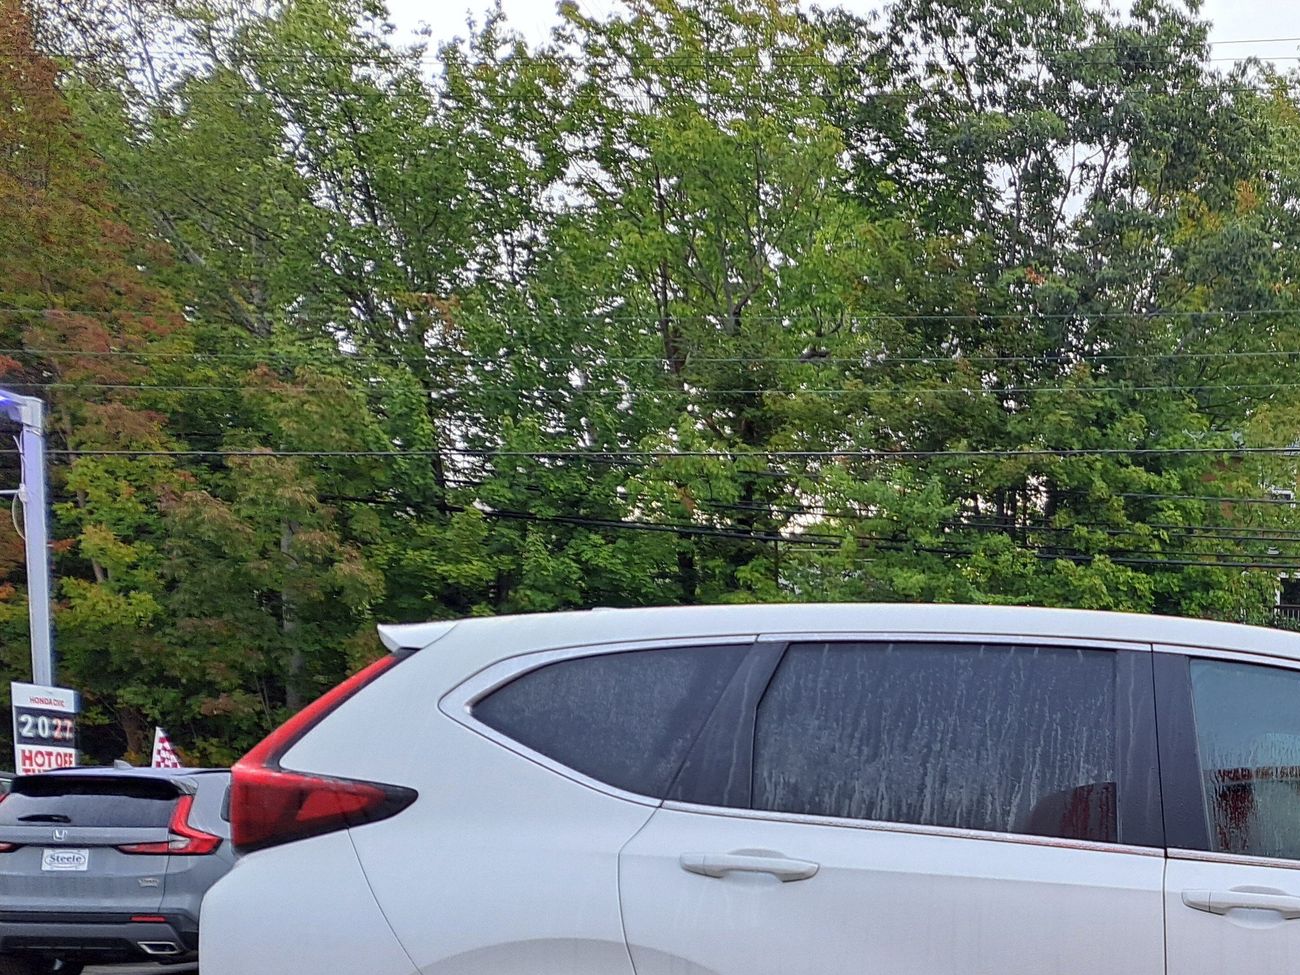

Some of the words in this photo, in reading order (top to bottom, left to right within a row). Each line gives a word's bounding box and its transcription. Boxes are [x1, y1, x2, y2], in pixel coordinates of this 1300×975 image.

[29, 696, 53, 706] HONDA
[21, 749, 53, 768] HOT
[55, 751, 73, 768] OFF
[49, 854, 82, 863] Steele
